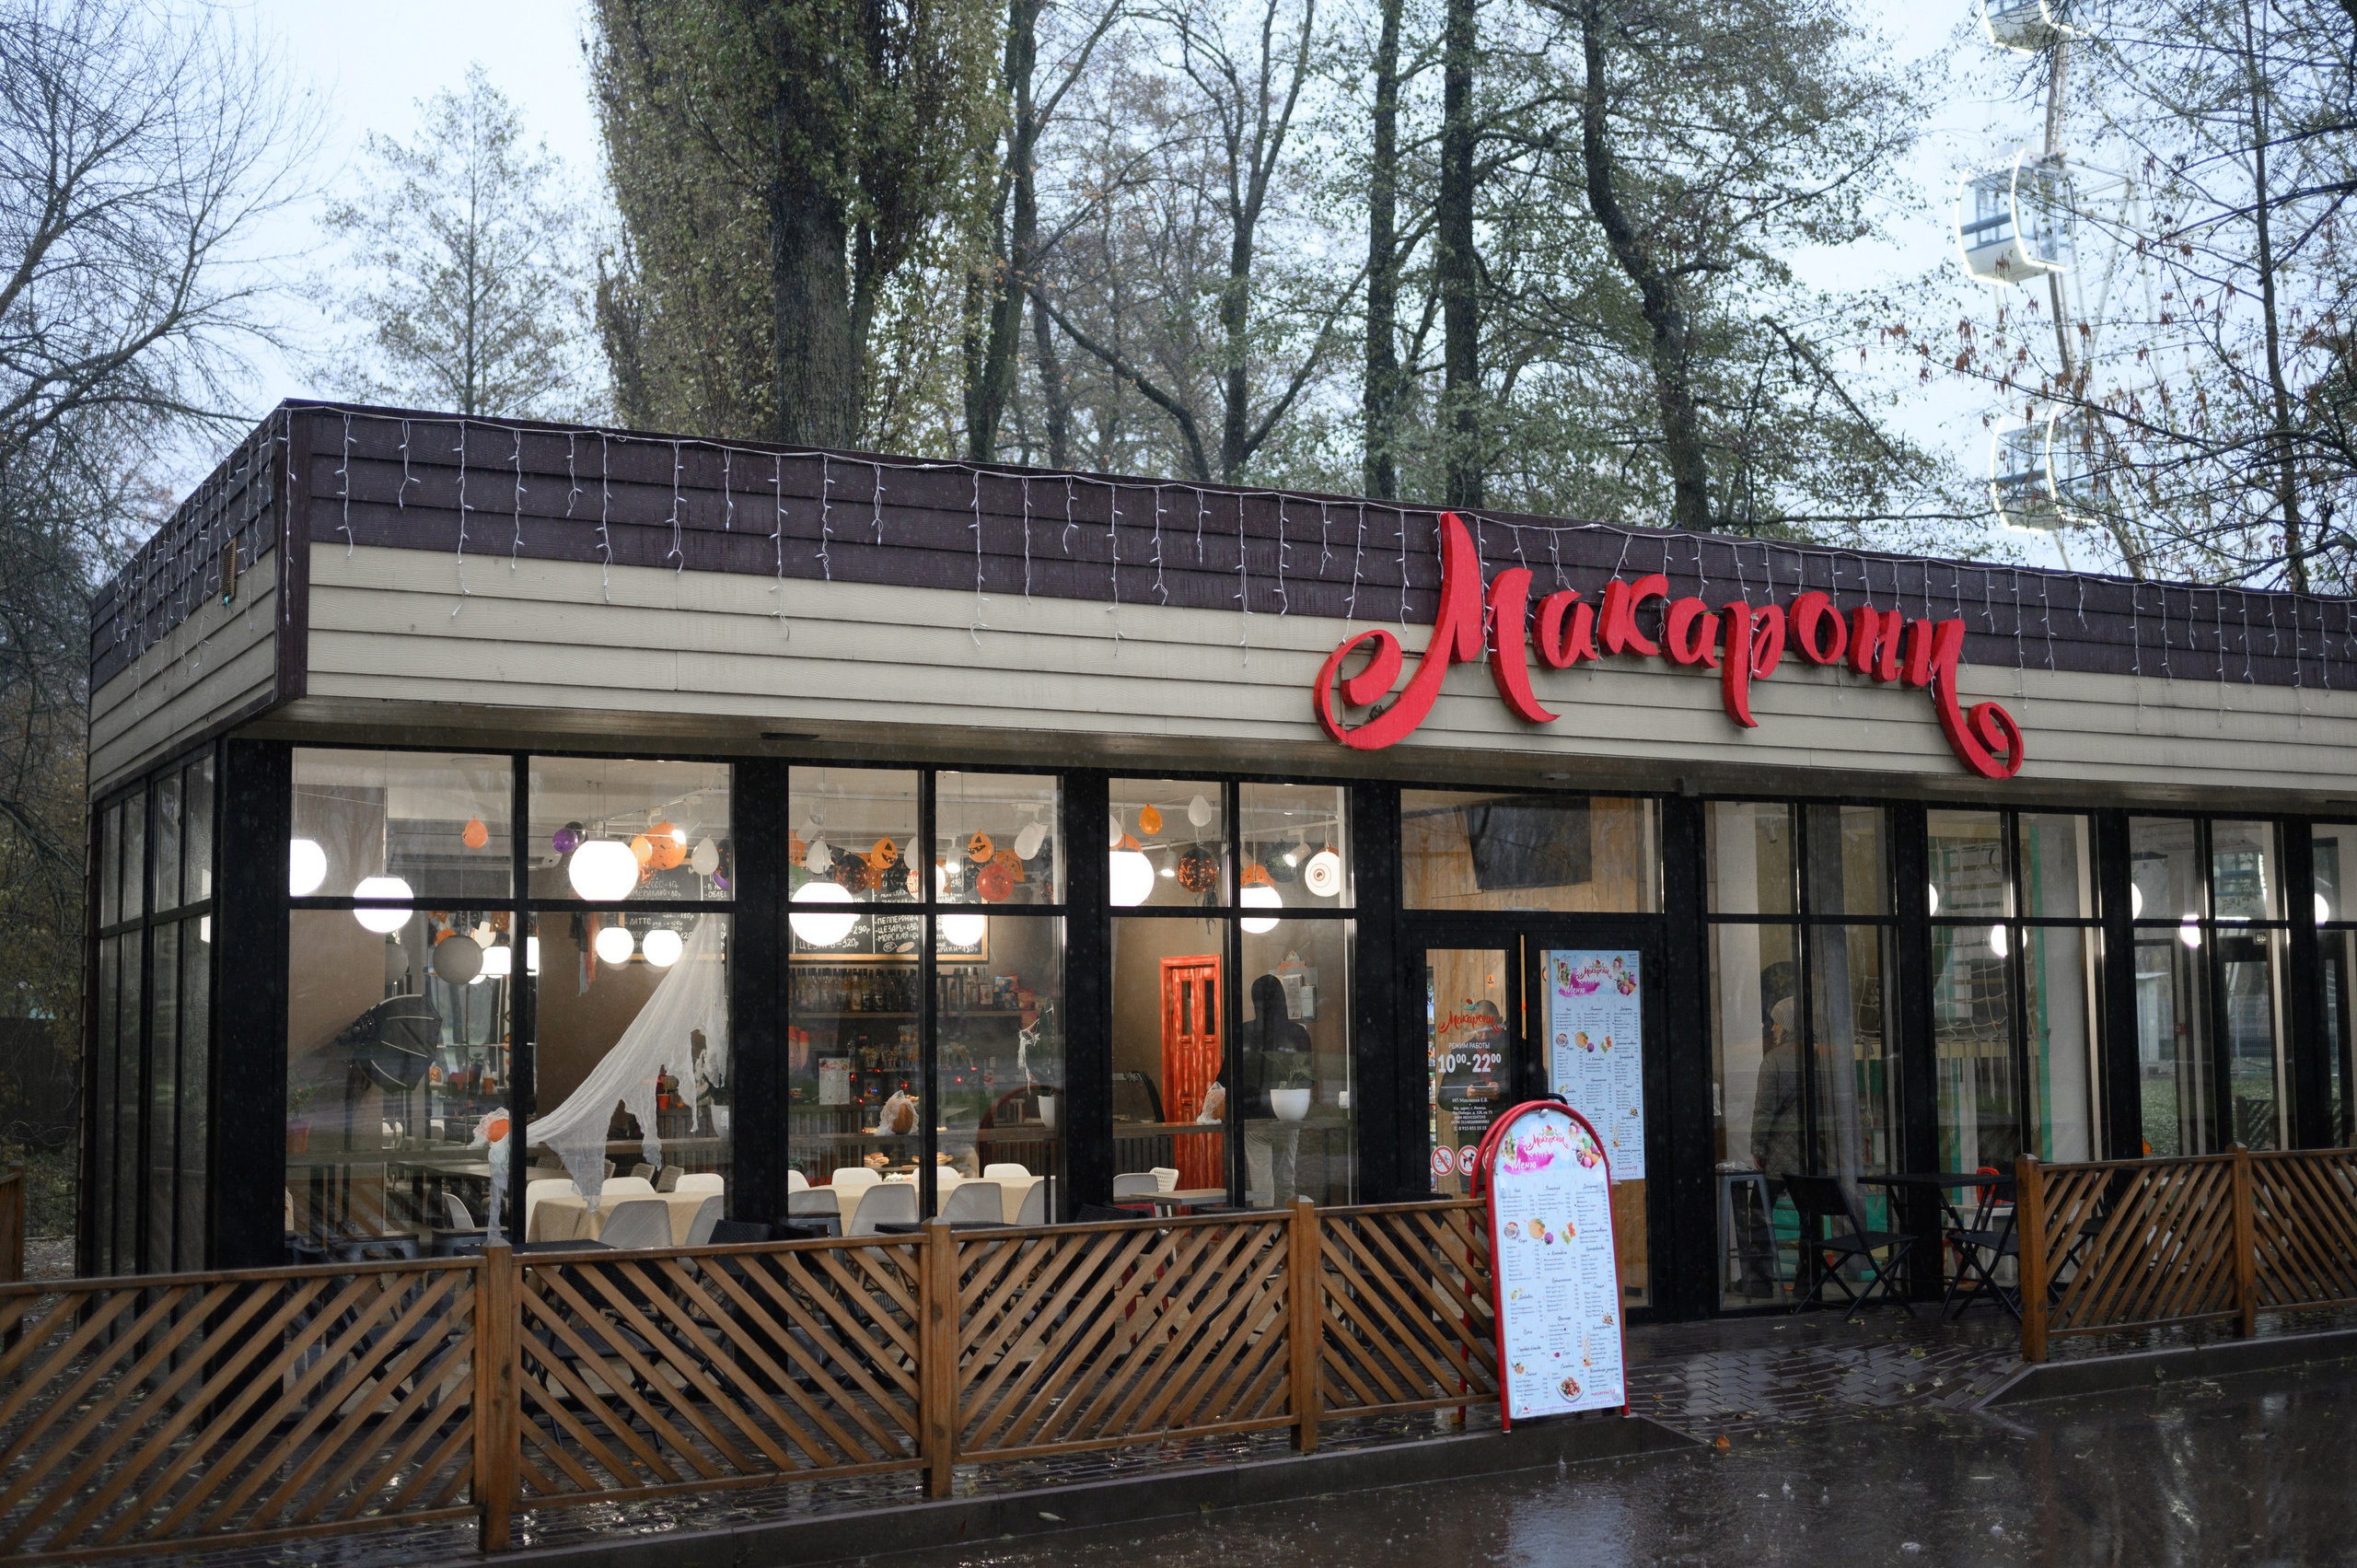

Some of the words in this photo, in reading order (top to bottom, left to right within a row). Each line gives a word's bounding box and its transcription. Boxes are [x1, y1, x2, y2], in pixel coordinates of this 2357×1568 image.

[1314, 511, 2024, 780] Макарони
[1437, 1010, 1502, 1034] Макарони
[1512, 1157, 1537, 1170] Меню
